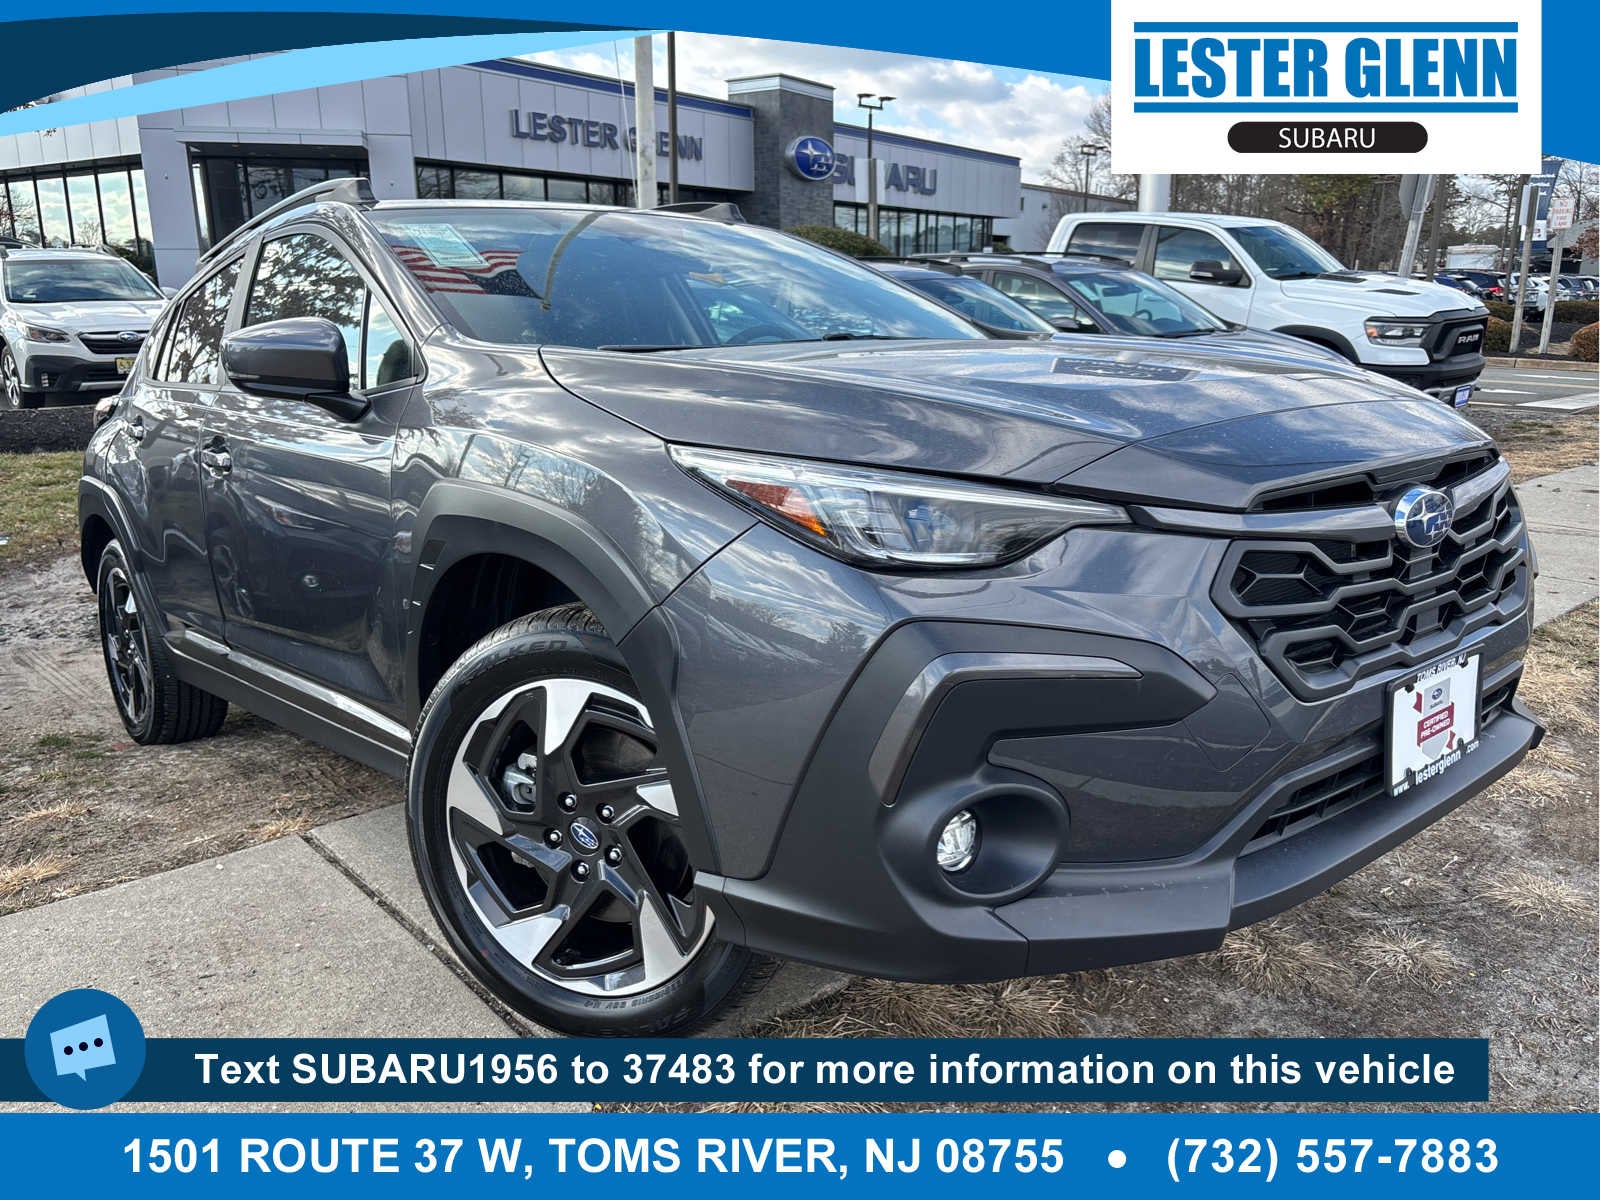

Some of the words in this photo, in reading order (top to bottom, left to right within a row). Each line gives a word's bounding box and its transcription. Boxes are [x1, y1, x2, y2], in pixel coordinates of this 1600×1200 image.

[510, 109, 619, 150] LESTER
[623, 127, 704, 161] GENN
[831, 152, 937, 196] SARU
[1457, 333, 1480, 344] RAM
